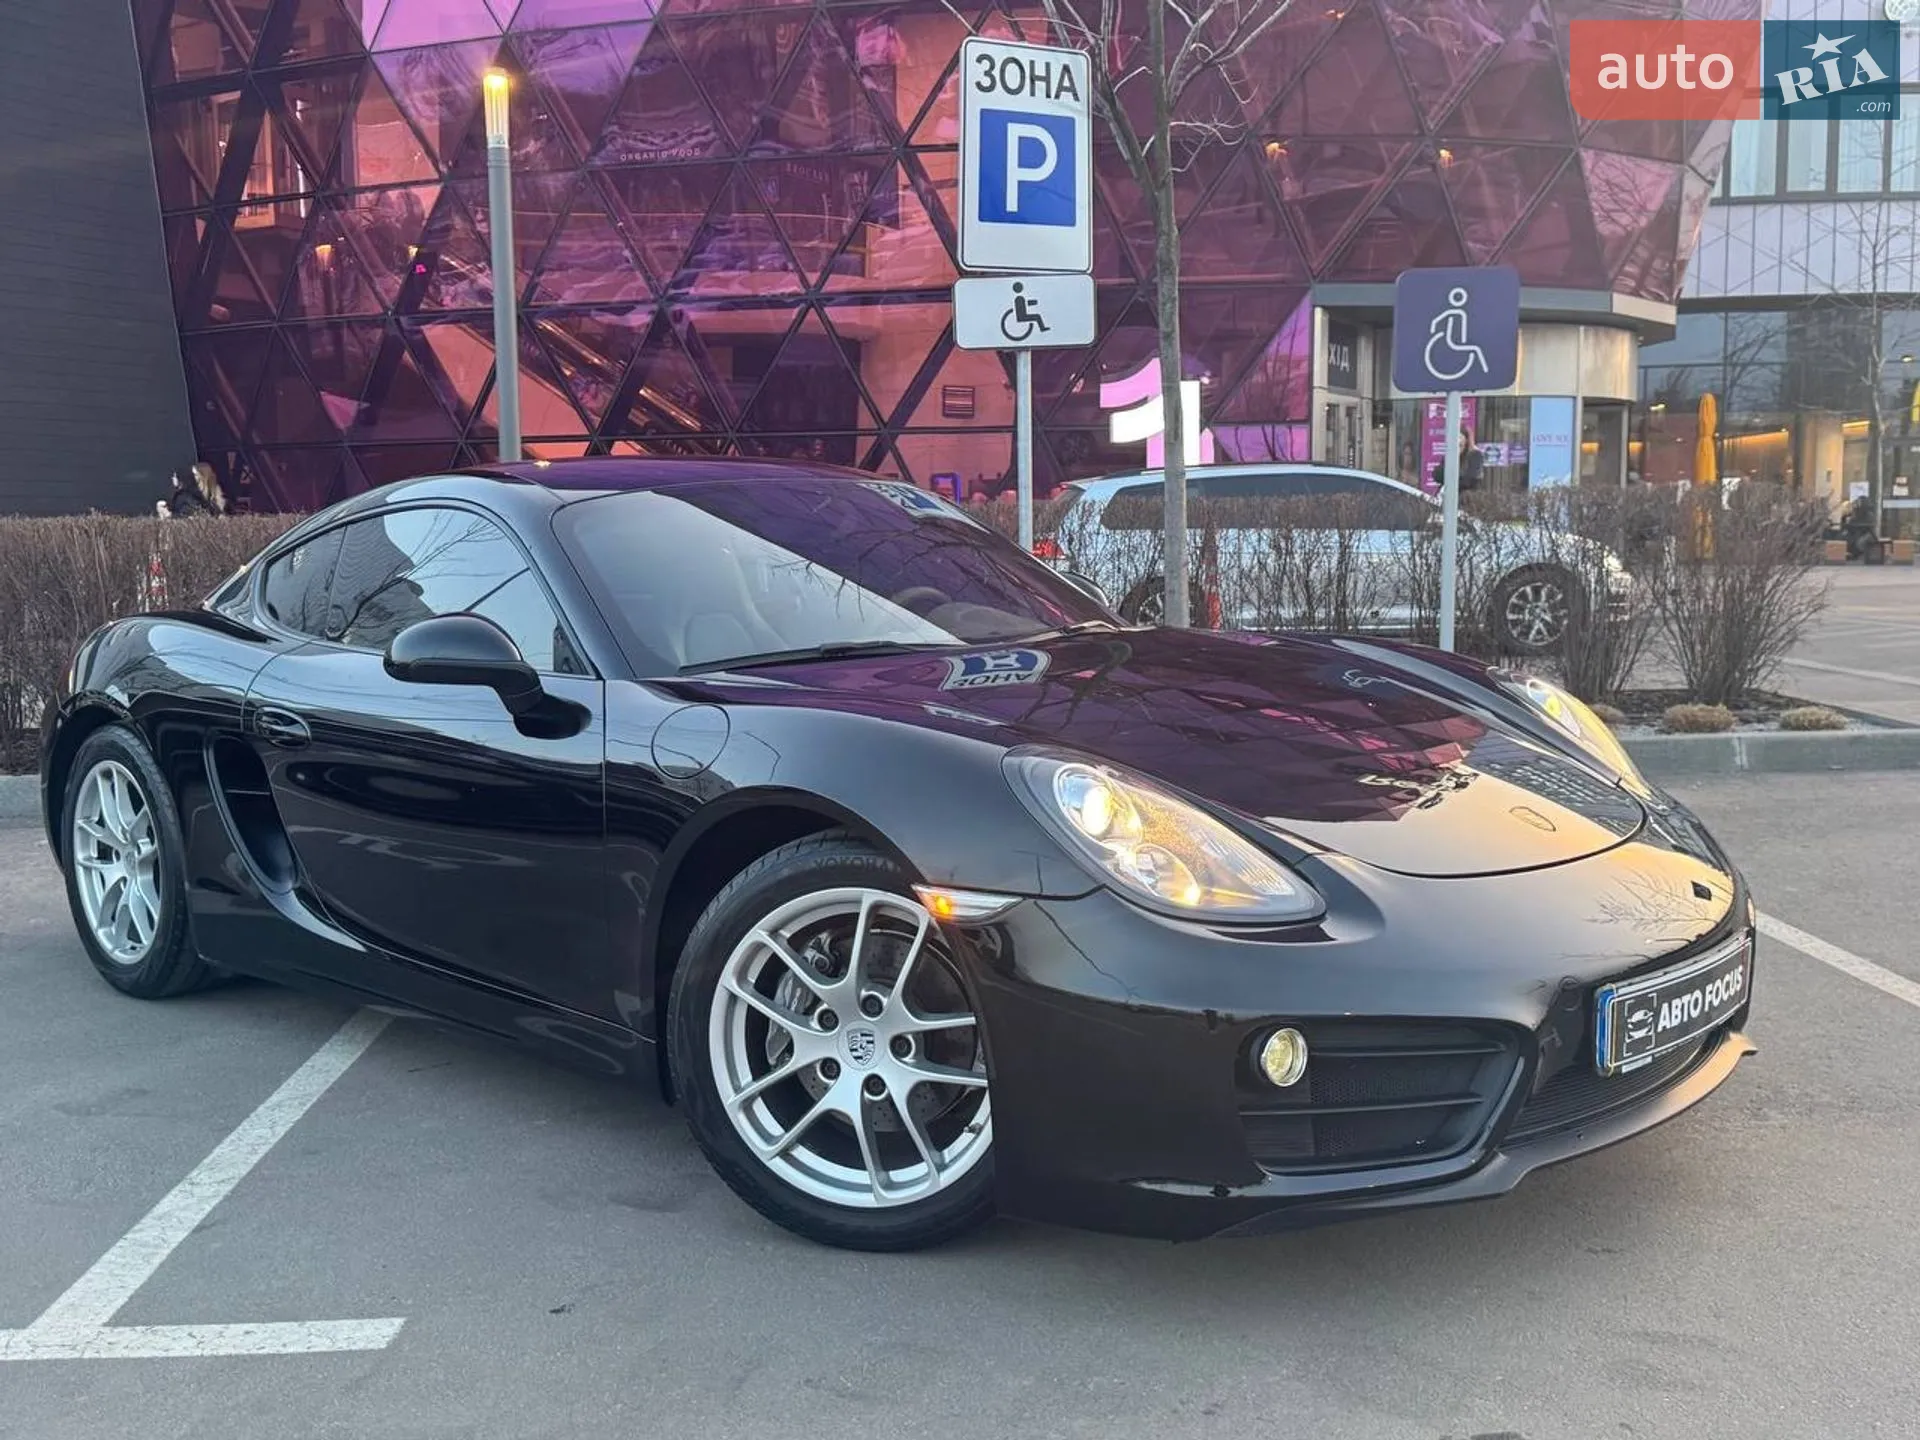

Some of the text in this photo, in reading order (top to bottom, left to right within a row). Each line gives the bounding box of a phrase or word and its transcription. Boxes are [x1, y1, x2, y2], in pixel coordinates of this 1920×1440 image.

[974, 53, 1081, 102] ЗОНА
[1006, 122, 1058, 213] P
[1328, 343, 1350, 373] ХІД
[1657, 966, 1743, 1032] АВТО FOCUS
